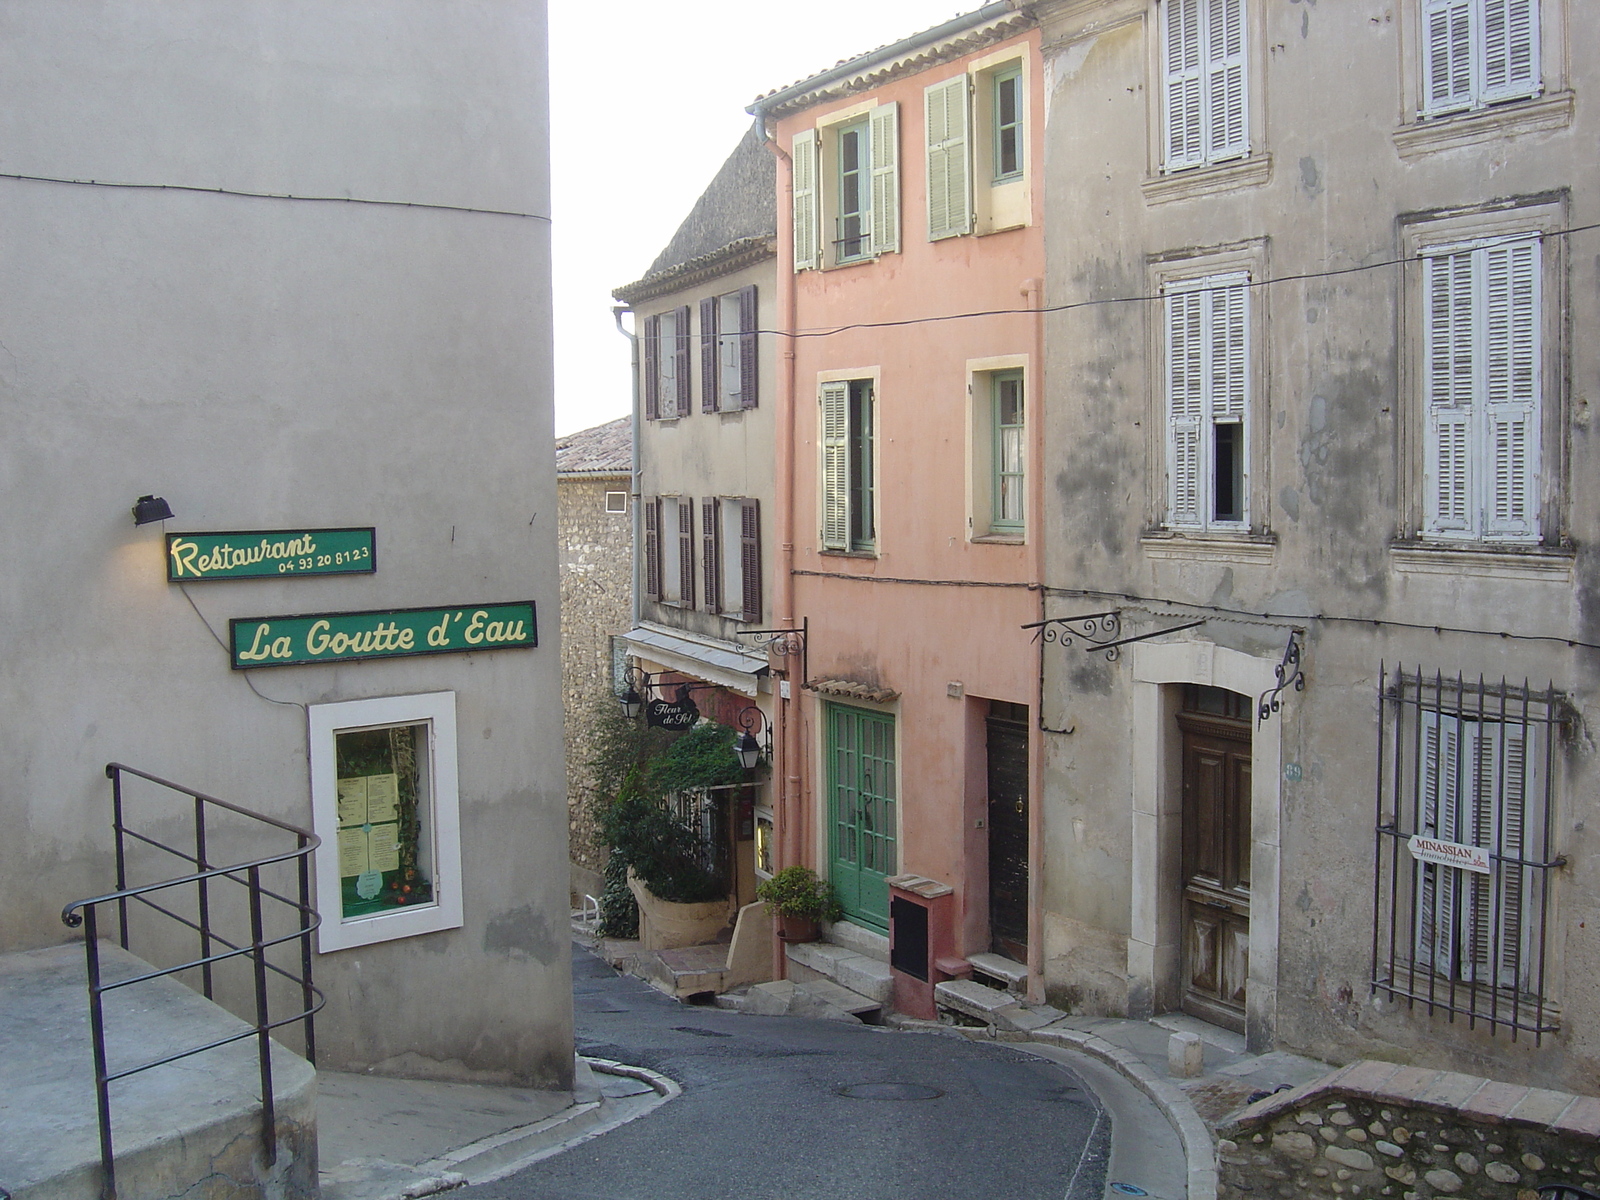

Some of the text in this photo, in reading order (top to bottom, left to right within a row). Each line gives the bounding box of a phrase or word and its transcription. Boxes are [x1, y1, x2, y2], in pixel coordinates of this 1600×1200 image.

[170, 533, 317, 577] Restaurant
[278, 560, 294, 573] 04
[298, 557, 313, 570] 93
[317, 554, 331, 567] 20
[239, 610, 526, 660] La Goutte d'Eau
[654, 703, 681, 715] Fleur
[663, 713, 692, 725] de Sel
[1416, 839, 1472, 859] MINASSIAN
